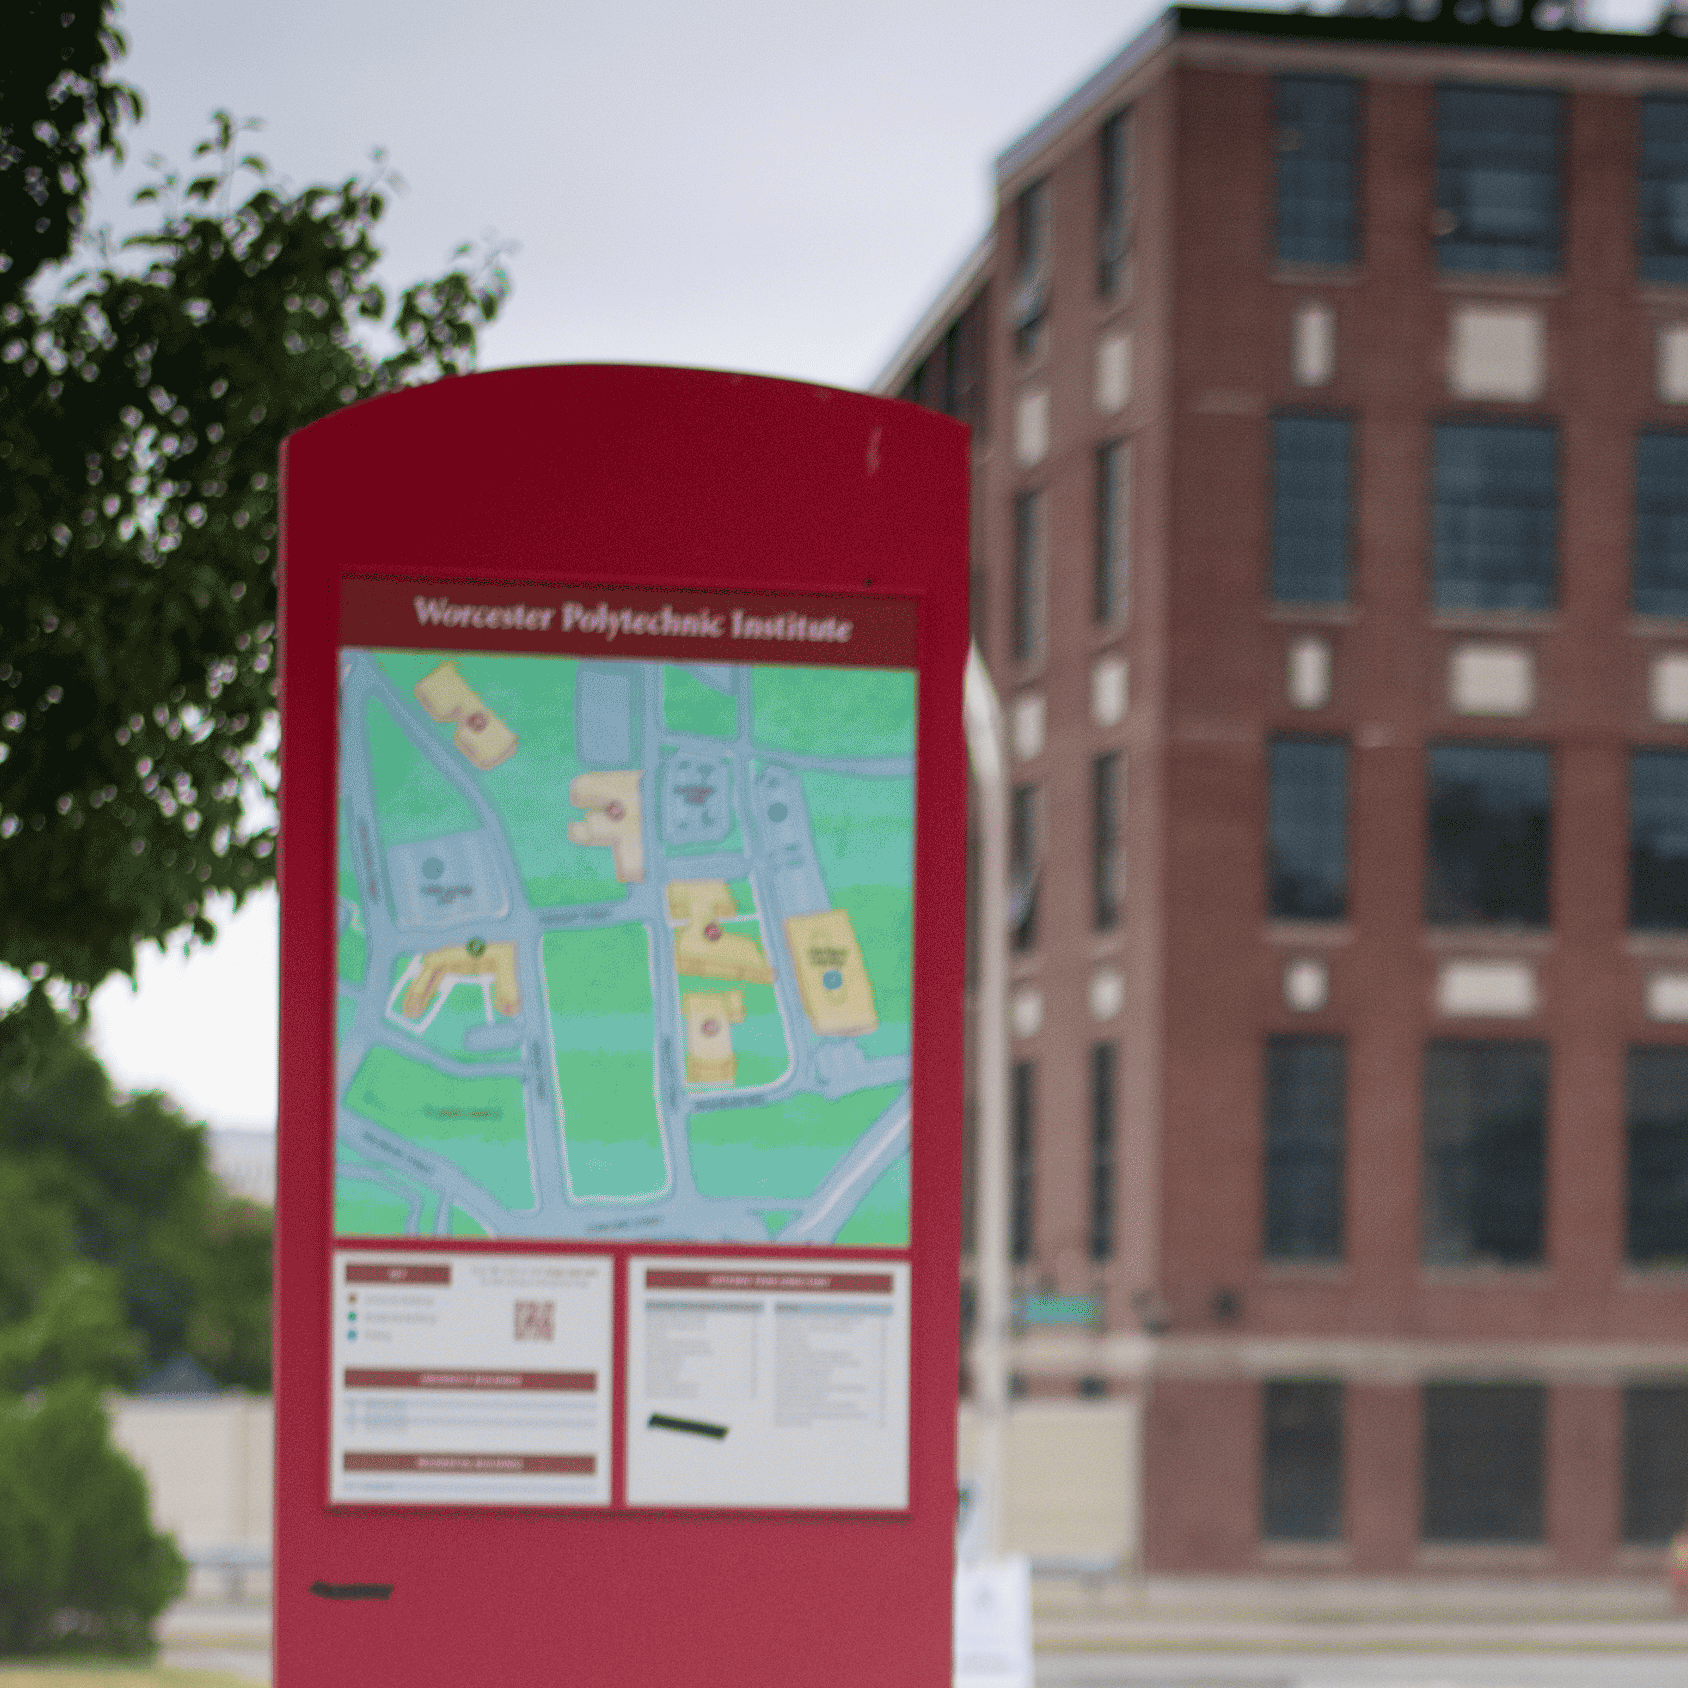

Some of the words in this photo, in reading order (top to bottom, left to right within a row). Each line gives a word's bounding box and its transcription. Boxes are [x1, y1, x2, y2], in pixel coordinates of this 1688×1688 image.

[413, 595, 554, 631] Worcester
[562, 602, 725, 641] Polytechnic
[731, 607, 854, 643] Institute
